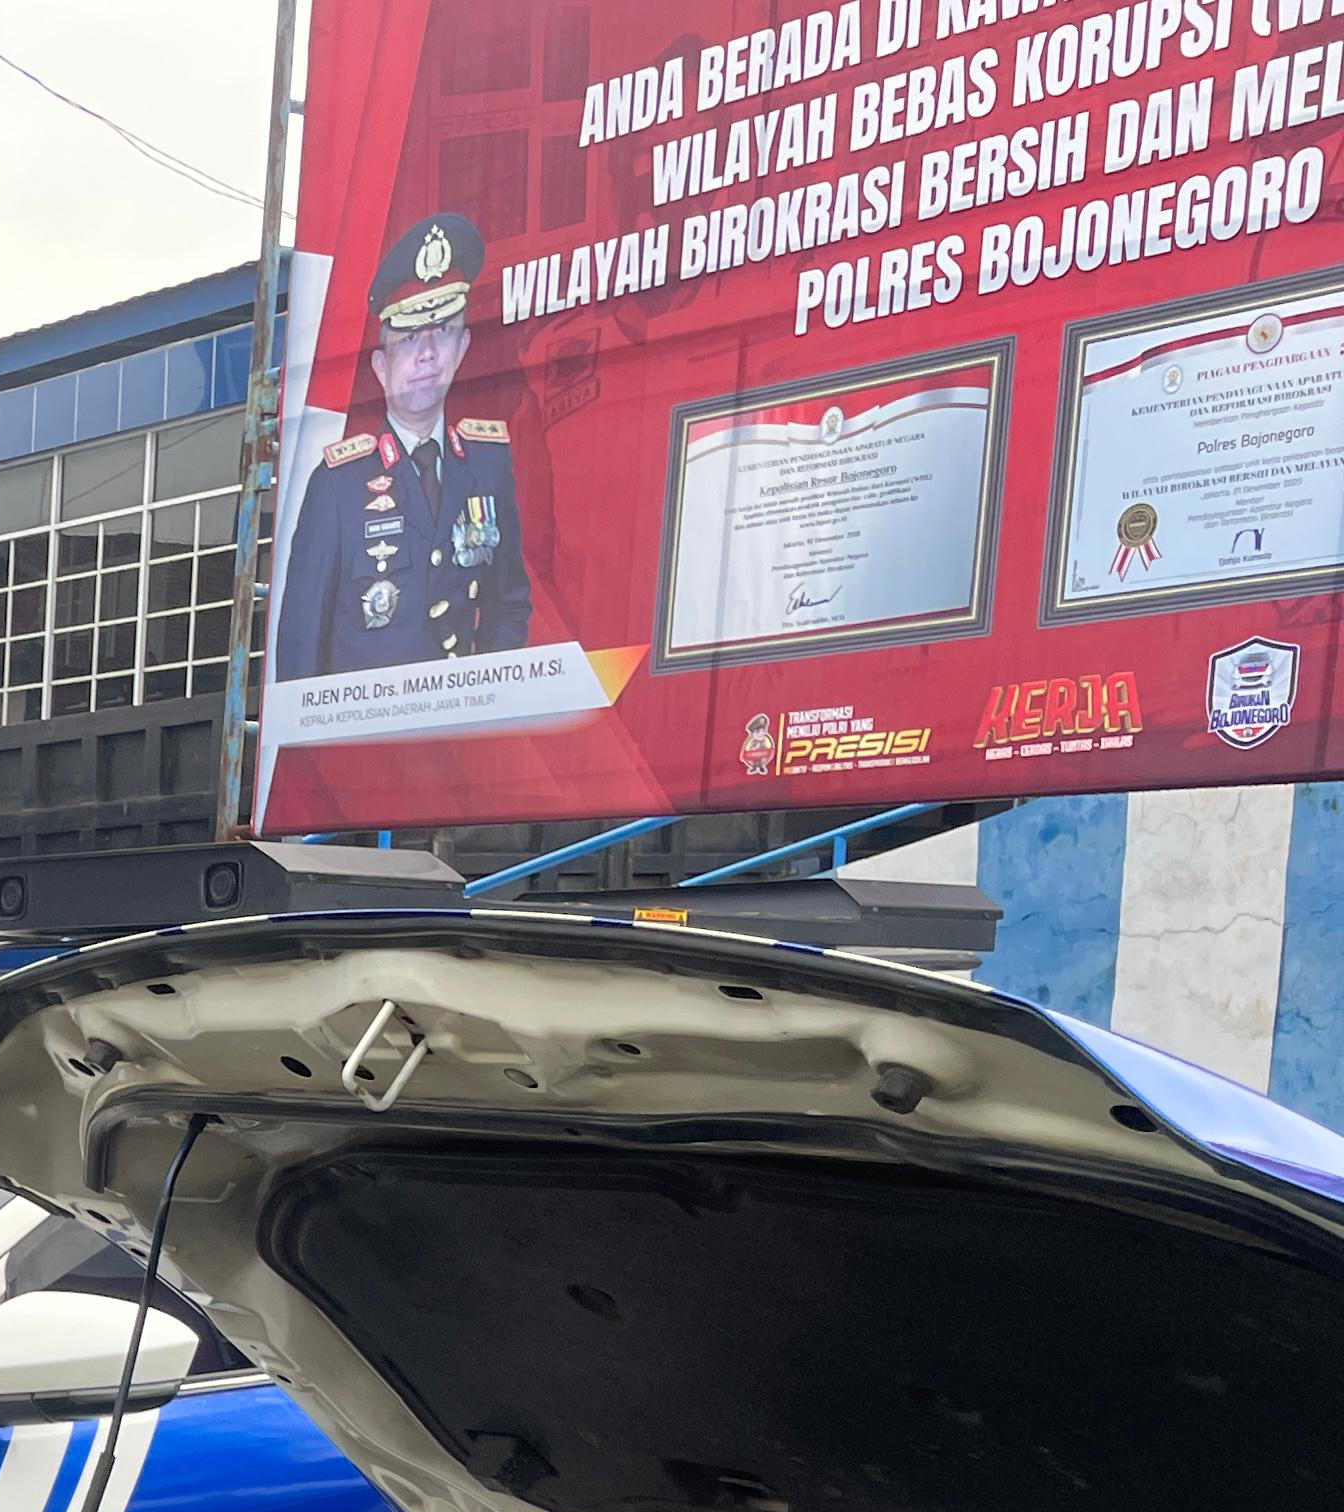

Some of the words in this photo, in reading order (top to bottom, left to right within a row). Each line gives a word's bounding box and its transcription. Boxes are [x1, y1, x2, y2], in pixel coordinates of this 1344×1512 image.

[579, 57, 683, 147] ANDA
[697, 1, 861, 111] BERADA
[876, 0, 922, 57] DI
[653, 93, 837, 206] WILAYAH
[850, 48, 998, 152] BEBAS
[1013, 0, 1231, 107] KORUPSI
[502, 224, 669, 325] WILAYAH
[680, 161, 905, 280] BIROKRASI
[918, 111, 1089, 220] BERSIH
[1104, 78, 1214, 175] DAN
[794, 235, 965, 336] POLRES
[978, 146, 1324, 295] BOJONEGORO
[1197, 438, 1237, 455] Polres
[1241, 426, 1315, 449] Bojonegoro
[302, 684, 339, 708] IRJEN
[343, 681, 368, 703] POL
[373, 678, 398, 699] Drs.
[403, 674, 443, 695] IMAM
[447, 664, 525, 689] SUGIANTO,
[529, 658, 566, 680] M.Si.
[973, 671, 1144, 749] KERJA
[300, 711, 334, 728] KEPALA
[785, 728, 931, 765] PRESISI
[1211, 703, 1290, 730] BOJONEGORO
